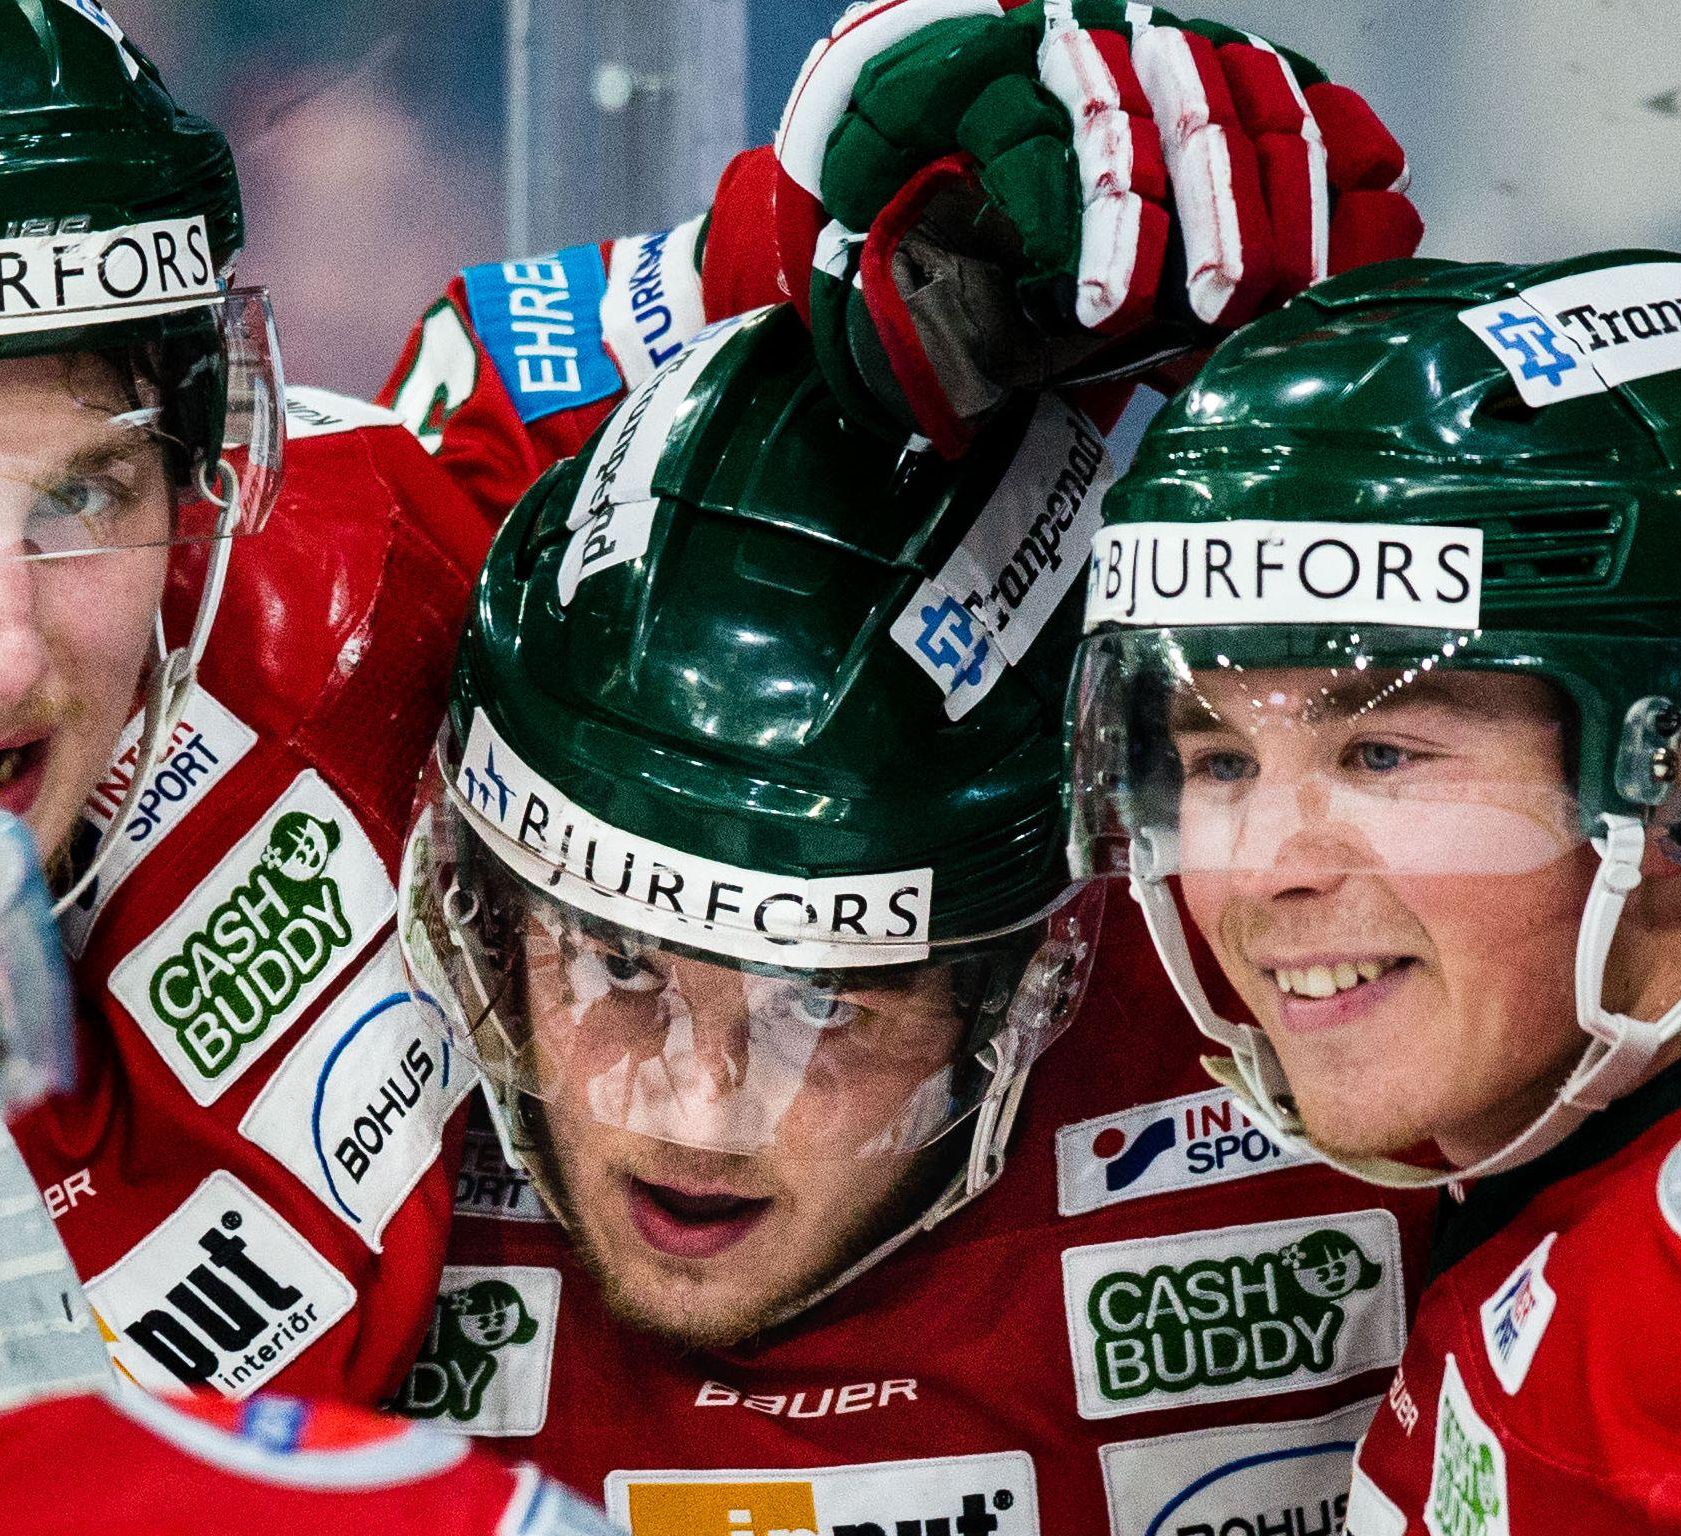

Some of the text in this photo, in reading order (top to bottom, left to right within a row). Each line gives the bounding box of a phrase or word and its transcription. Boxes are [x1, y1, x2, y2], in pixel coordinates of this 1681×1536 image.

[503, 253, 582, 393] EHRE
[1105, 537, 1471, 617] BJURFORS
[124, 734, 220, 842] SPORT
[519, 792, 921, 945] BJURFORS
[157, 877, 292, 1020] CASH
[185, 884, 350, 1075] BUDDY
[335, 1038, 435, 1185] BOHUS
[1186, 1128, 1281, 1174] SPO
[125, 1227, 305, 1385] put
[218, 1304, 320, 1390] interiör
[1099, 1260, 1277, 1331] CASH
[694, 1378, 919, 1419] BAUER
[1106, 1310, 1337, 1394] BUDDY
